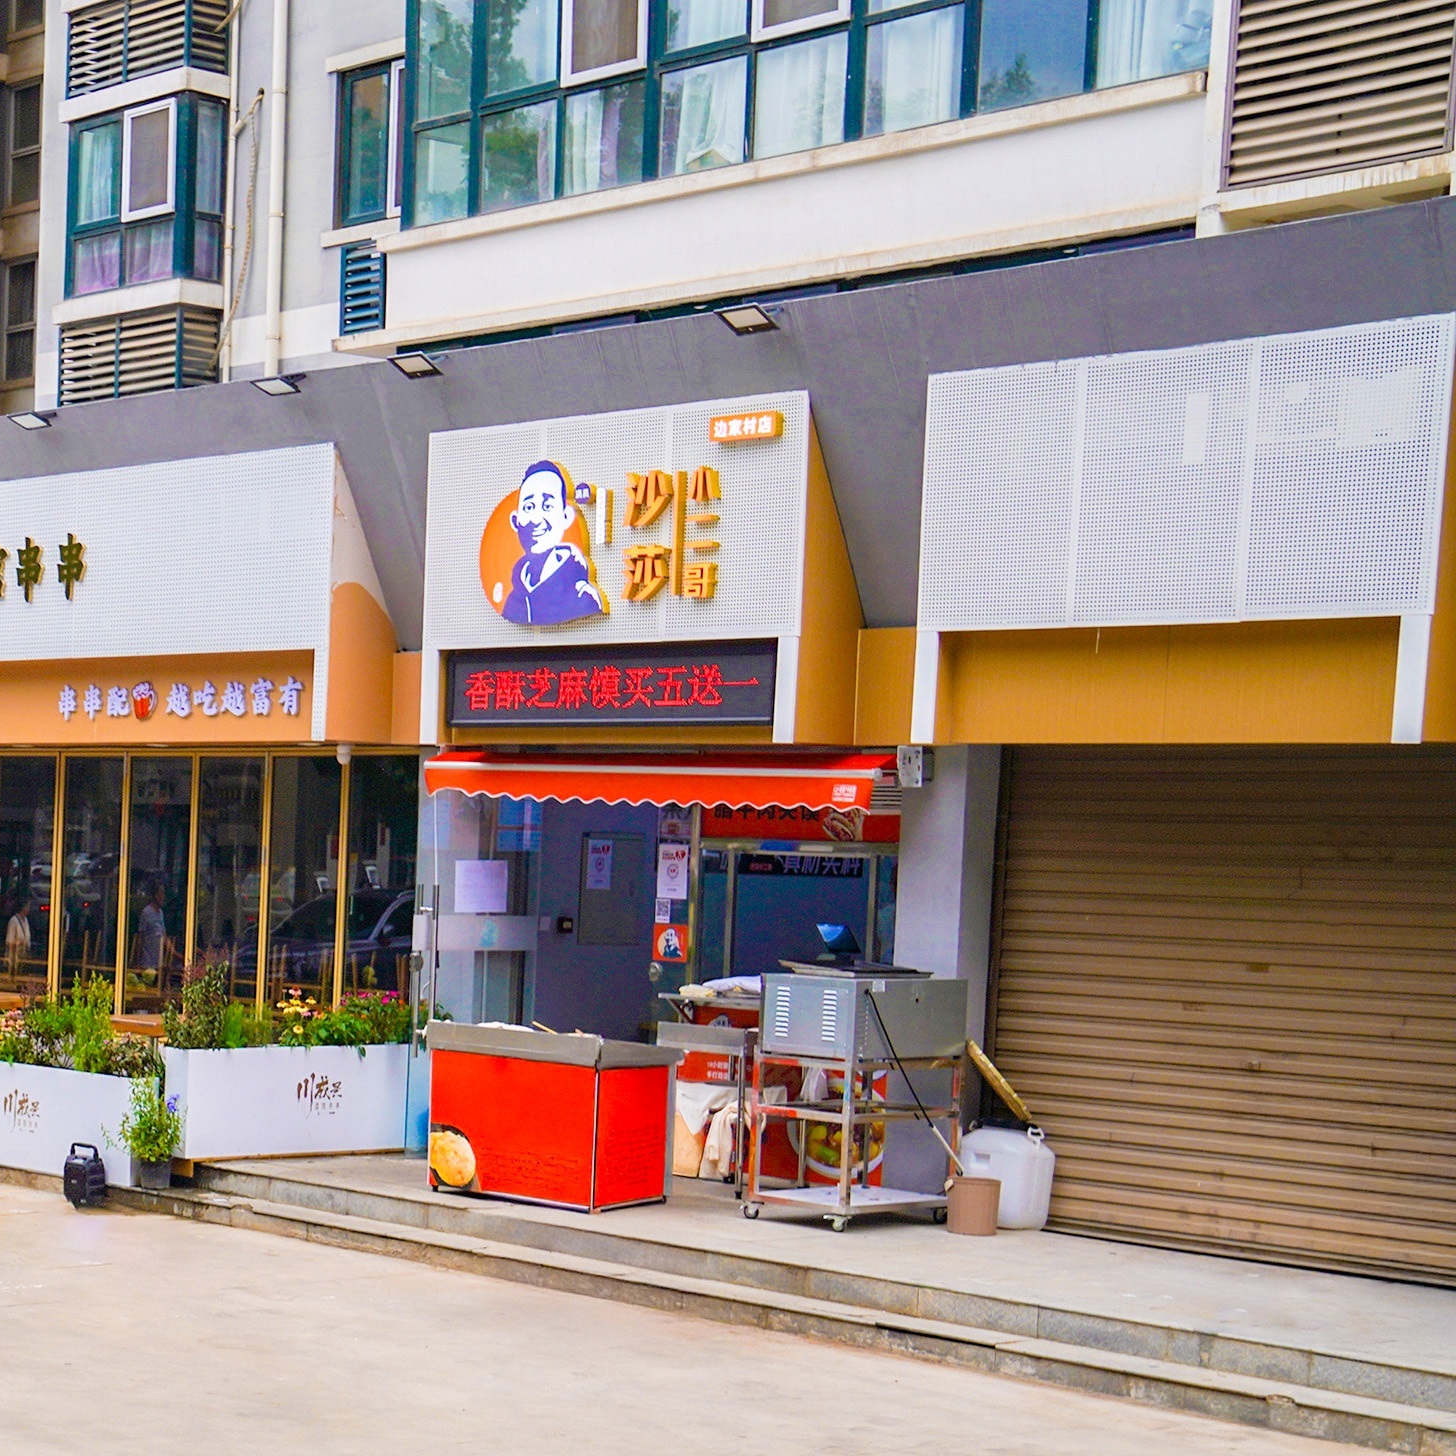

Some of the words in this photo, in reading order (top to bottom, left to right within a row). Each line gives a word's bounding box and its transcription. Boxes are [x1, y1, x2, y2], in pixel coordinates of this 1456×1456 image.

[713, 415, 774, 438] 边家村店
[58, 684, 131, 721] 串串配
[165, 676, 303, 718] 越吃越富有
[464, 664, 759, 711] 香酥芝麻馍买五送一
